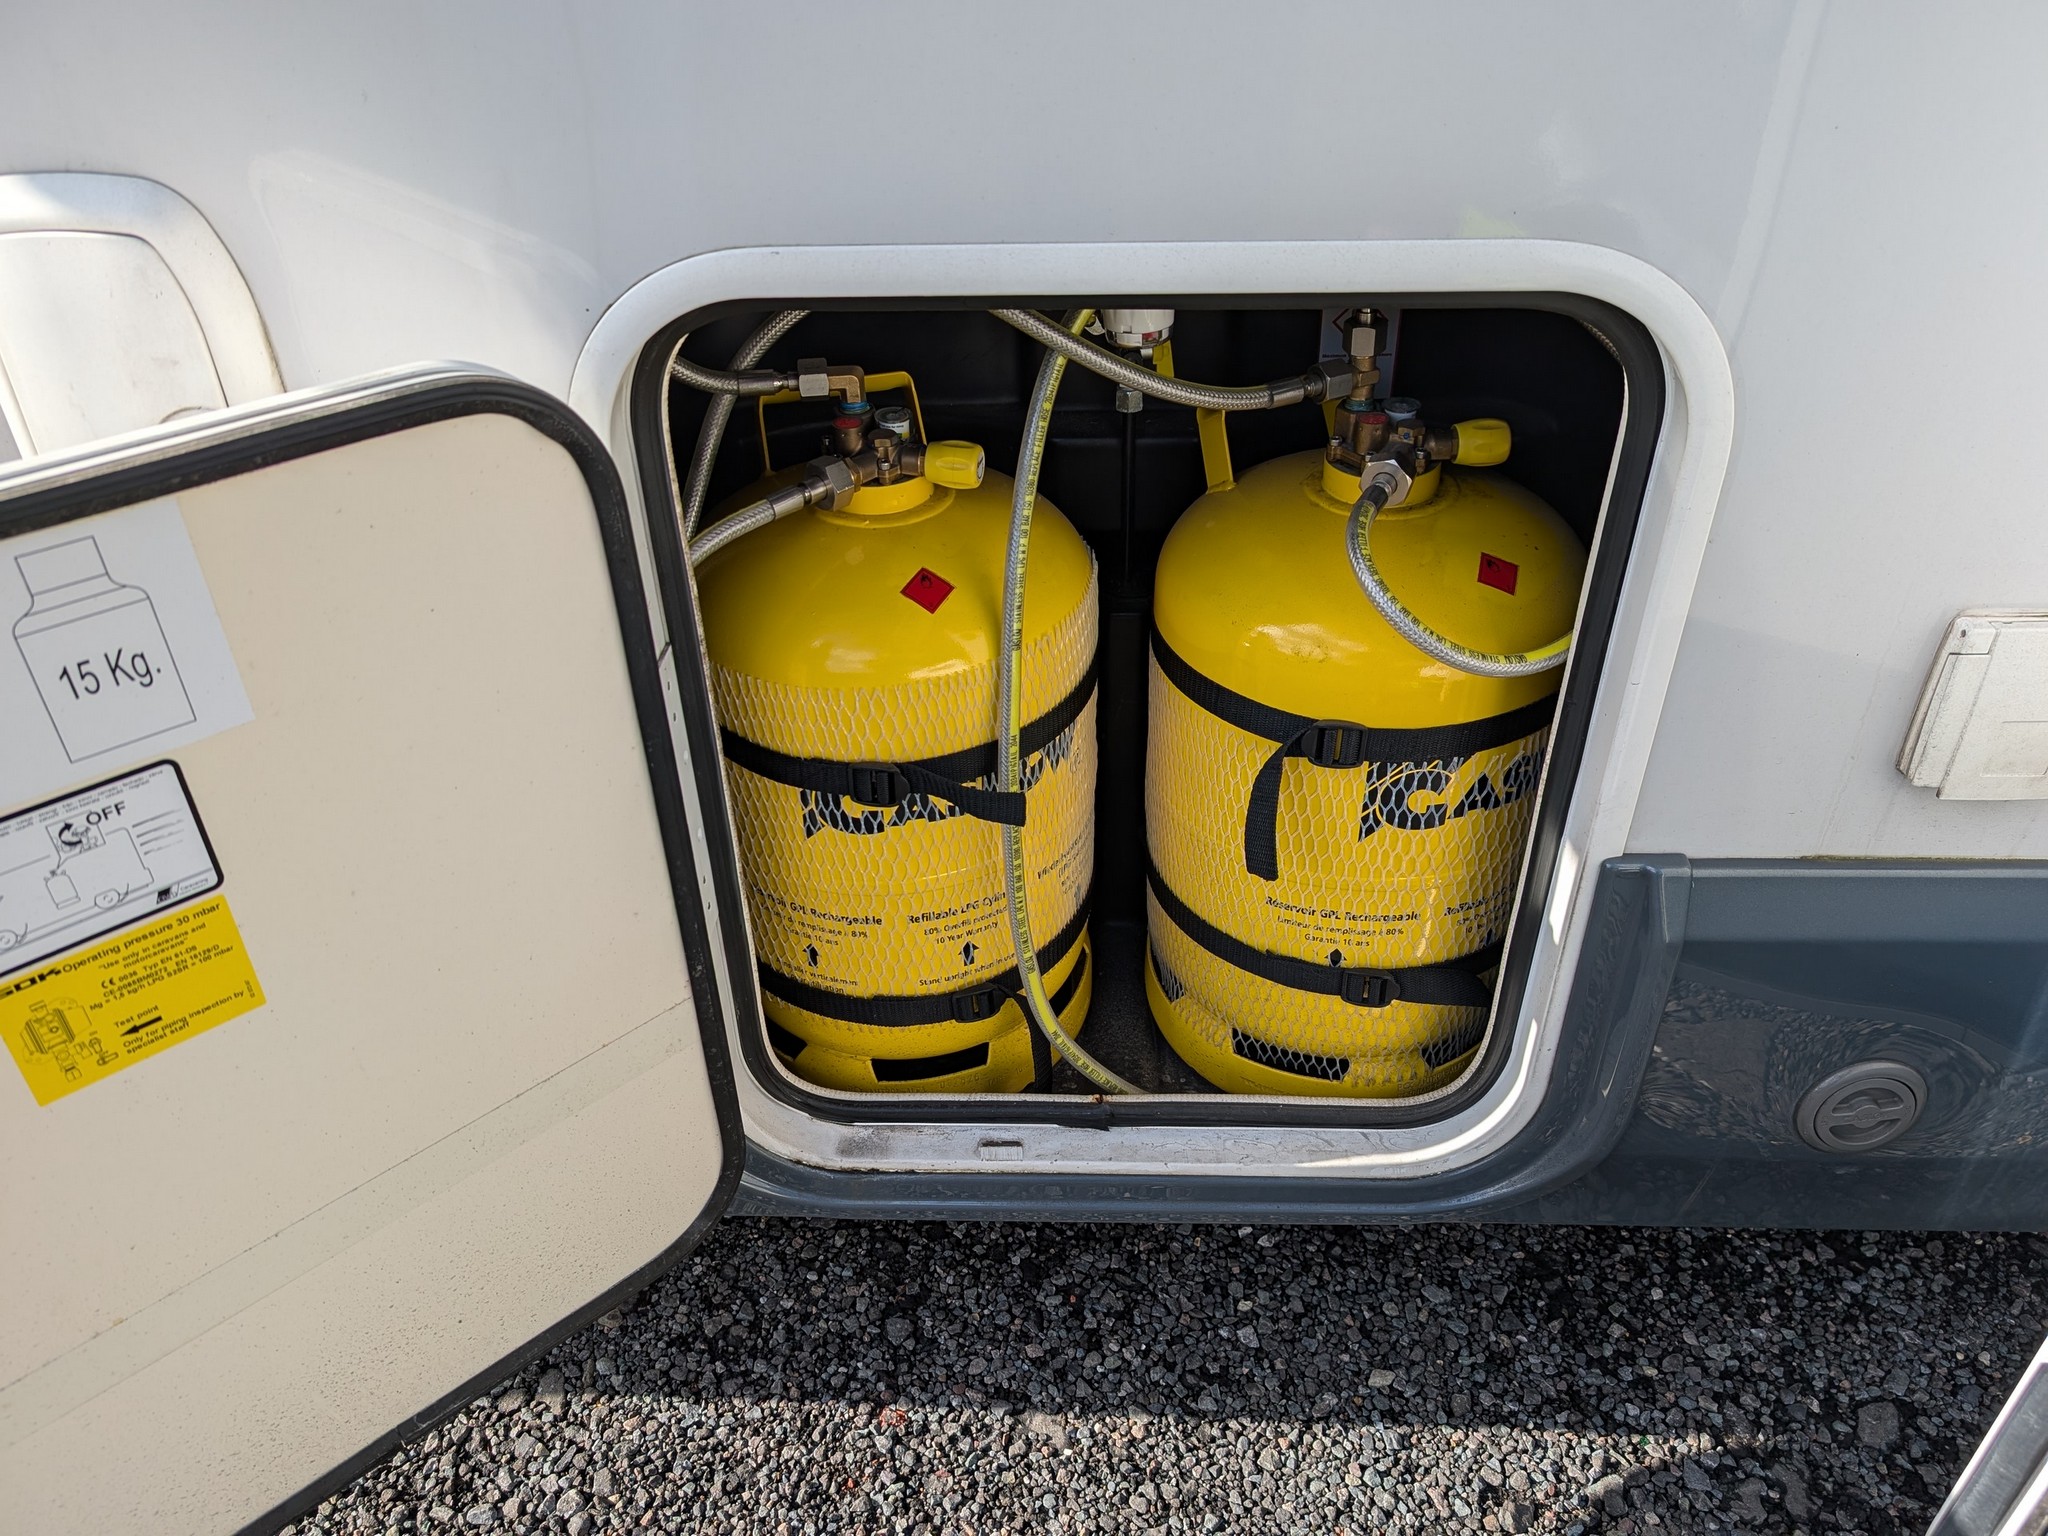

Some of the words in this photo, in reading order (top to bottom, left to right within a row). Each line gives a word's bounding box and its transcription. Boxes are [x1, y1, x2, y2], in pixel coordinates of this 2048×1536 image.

[1041, 407, 1050, 422] HOSE
[1035, 426, 1046, 447] FILLER
[1021, 529, 1029, 539] 100
[1018, 557, 1026, 568] LPG
[1016, 572, 1024, 589] STEEL
[1013, 592, 1023, 623] STAINLESS
[1411, 616, 1421, 627] 100
[1012, 629, 1021, 651] GASLOW
[1435, 634, 1447, 645] LPG
[1449, 641, 1466, 654] STEEL
[1468, 650, 1500, 663] STAINLESS
[1504, 655, 1527, 664] GASLOW
[59, 660, 100, 700] 15
[105, 648, 162, 688] Kg.
[1009, 734, 1018, 748] 2044
[86, 801, 127, 826] OFF
[1014, 885, 1022, 893] 100
[908, 907, 958, 924] Refillable
[983, 891, 1006, 907] Cylin
[1016, 905, 1024, 915] LPG
[1018, 916, 1026, 929] STEEL
[1344, 910, 1421, 925] Rechargeable
[61, 943, 121, 974] Operating
[122, 922, 174, 949] pressure
[175, 914, 190, 926] 30
[191, 902, 221, 920] mbar
[121, 950, 139, 962] only
[141, 945, 150, 953] in
[151, 929, 189, 949] caravans
[190, 922, 206, 933] and
[936, 937, 945, 945] 10
[947, 931, 964, 942] Year
[1020, 930, 1031, 954] STAINLESS
[142, 961, 159, 972] Typ
[159, 955, 172, 964] EN
[174, 957, 187, 966] EN
[1026, 956, 1036, 974] GASLOW
[89, 1001, 103, 1011] Mg
[126, 982, 145, 995] kg/h
[146, 974, 165, 986] LPG
[198, 954, 212, 963] 100
[213, 944, 234, 957] mbar
[113, 1015, 134, 1028] Test
[136, 1003, 159, 1019] point
[122, 1034, 144, 1049] Only
[145, 1027, 158, 1037] for
[160, 1014, 187, 1032] piping
[187, 993, 232, 1019] inspection
[233, 988, 244, 998] by
[125, 1031, 167, 1055] specialist
[169, 1020, 190, 1034] staff
